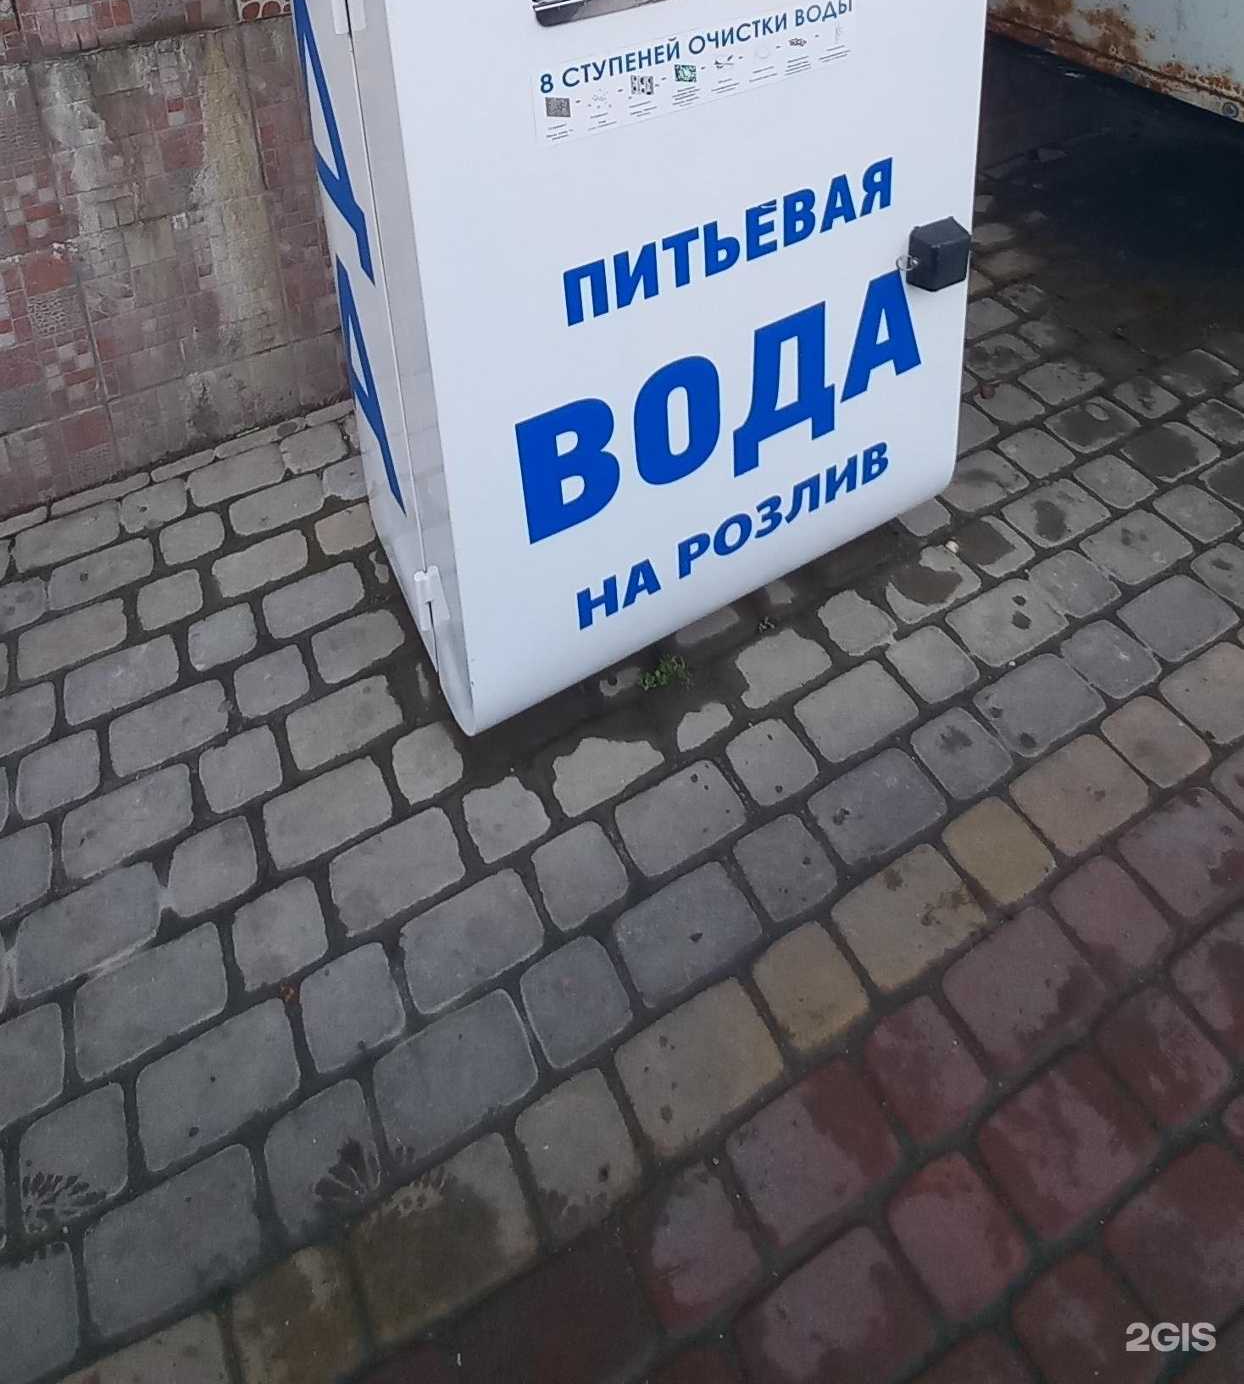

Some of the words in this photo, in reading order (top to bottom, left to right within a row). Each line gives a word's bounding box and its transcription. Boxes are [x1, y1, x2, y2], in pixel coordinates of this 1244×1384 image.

[540, 73, 554, 94] 8
[562, 37, 680, 87] СТУПЕНЕЙ
[688, 12, 788, 55] ОЧИСТКИ
[562, 156, 894, 327] ПИТЬЕВАЯ
[514, 269, 922, 545] ВОДА
[576, 558, 662, 631] НА
[677, 441, 890, 579] РОЗЛИВ
